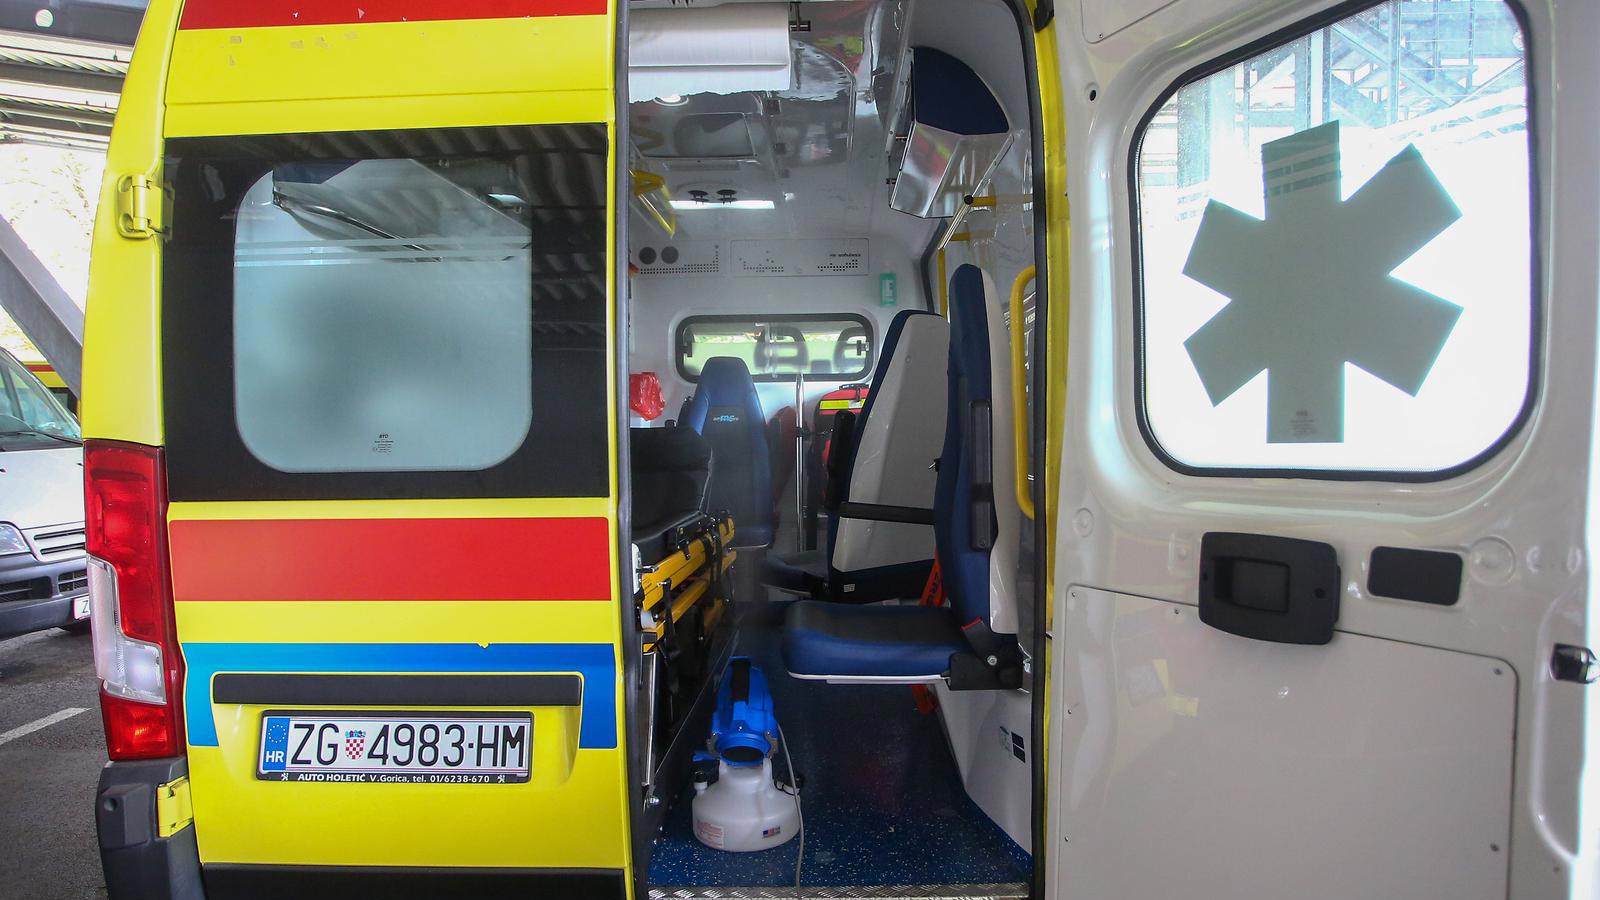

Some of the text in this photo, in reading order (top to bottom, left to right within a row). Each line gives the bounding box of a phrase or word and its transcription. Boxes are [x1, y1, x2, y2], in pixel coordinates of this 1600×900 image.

[290, 723, 340, 766] ZG
[265, 751, 285, 763] HR
[297, 773, 324, 782] AUTO
[326, 773, 366, 782] HOLETIĆ
[412, 774, 427, 783] tel.
[429, 775, 490, 783] 01/6238-670
